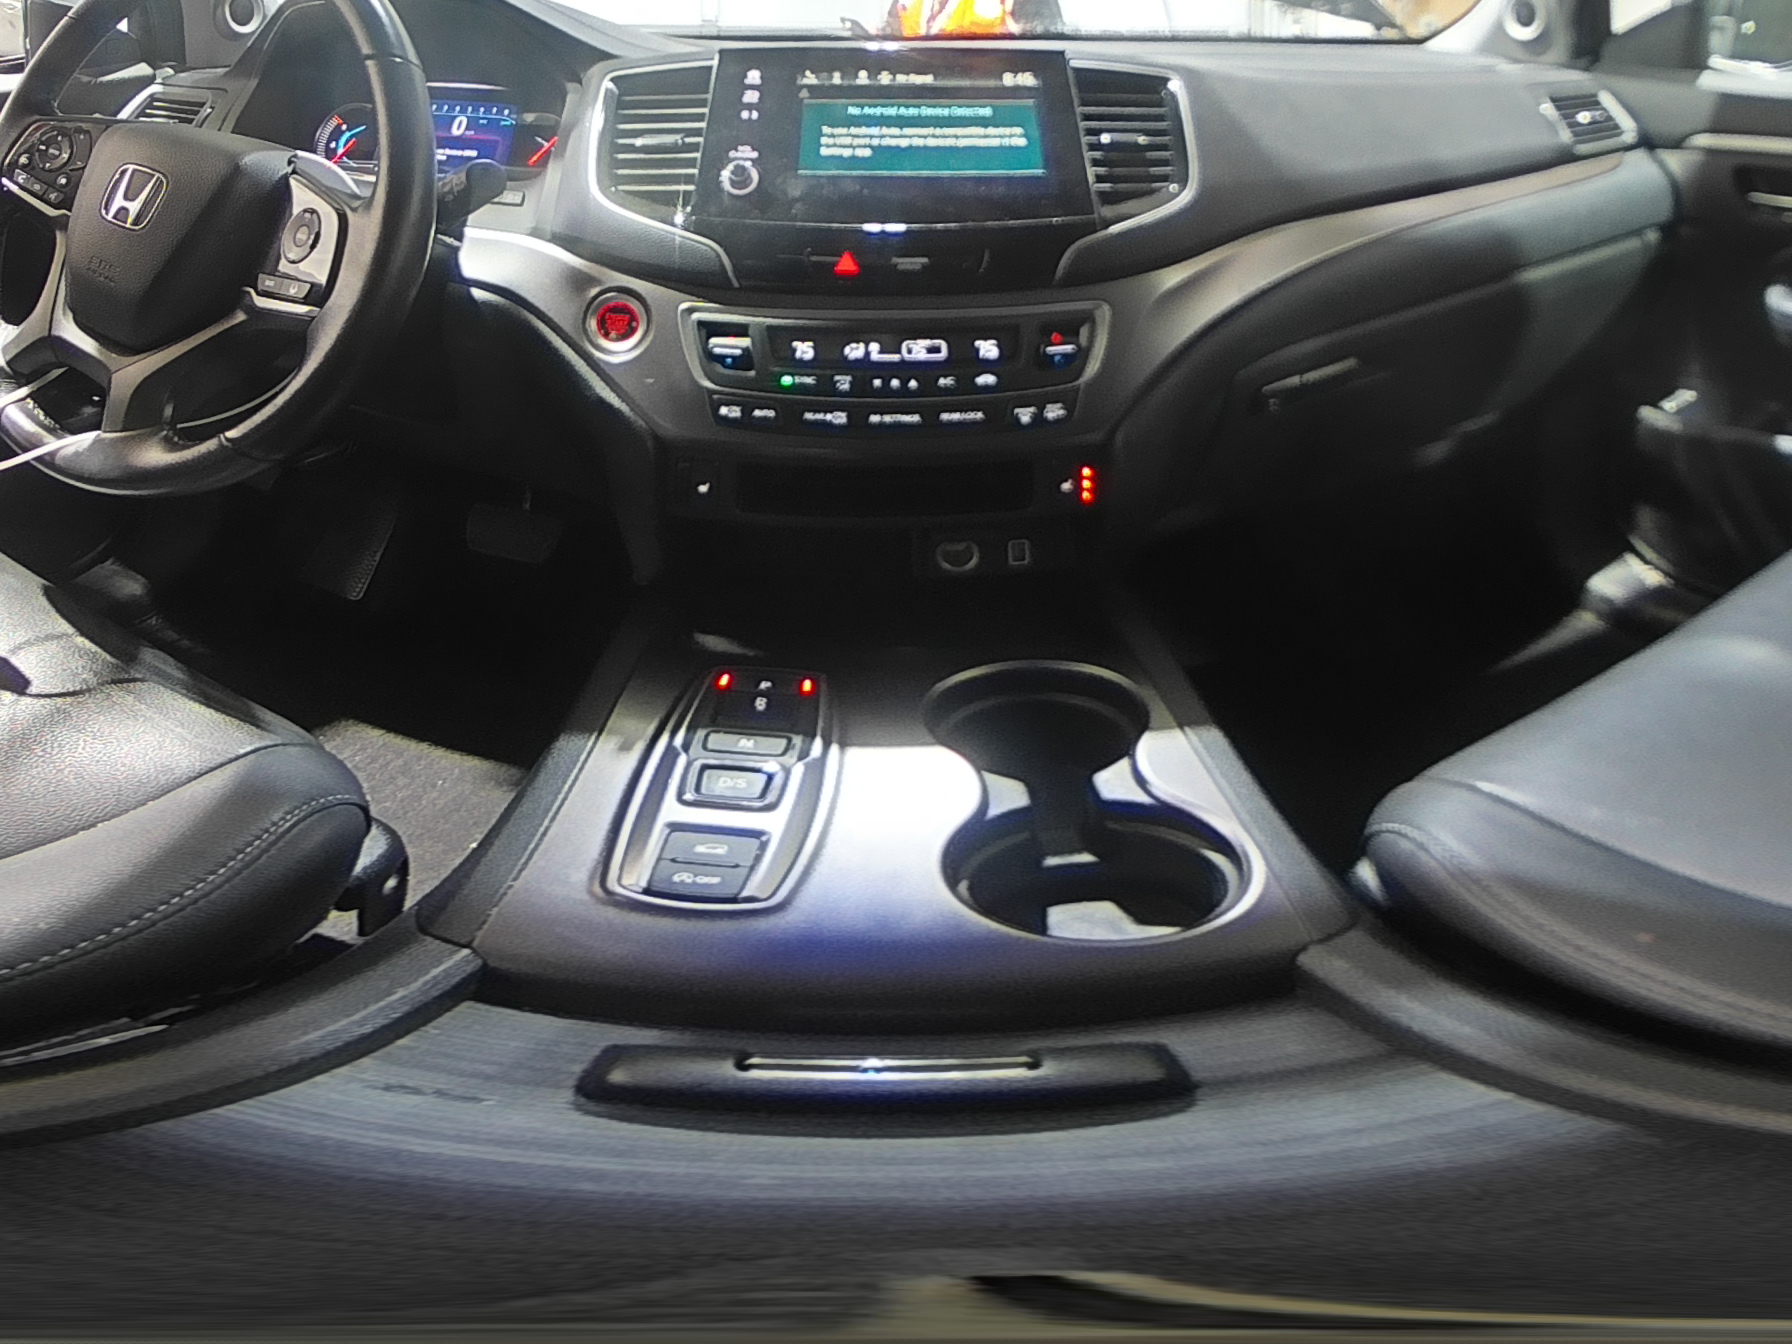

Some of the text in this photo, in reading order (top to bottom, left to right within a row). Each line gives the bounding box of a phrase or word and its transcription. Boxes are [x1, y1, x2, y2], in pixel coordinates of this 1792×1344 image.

[451, 115, 468, 136] 0
[791, 340, 815, 361] 75
[973, 339, 1000, 361] 75
[718, 776, 748, 789] D/S
